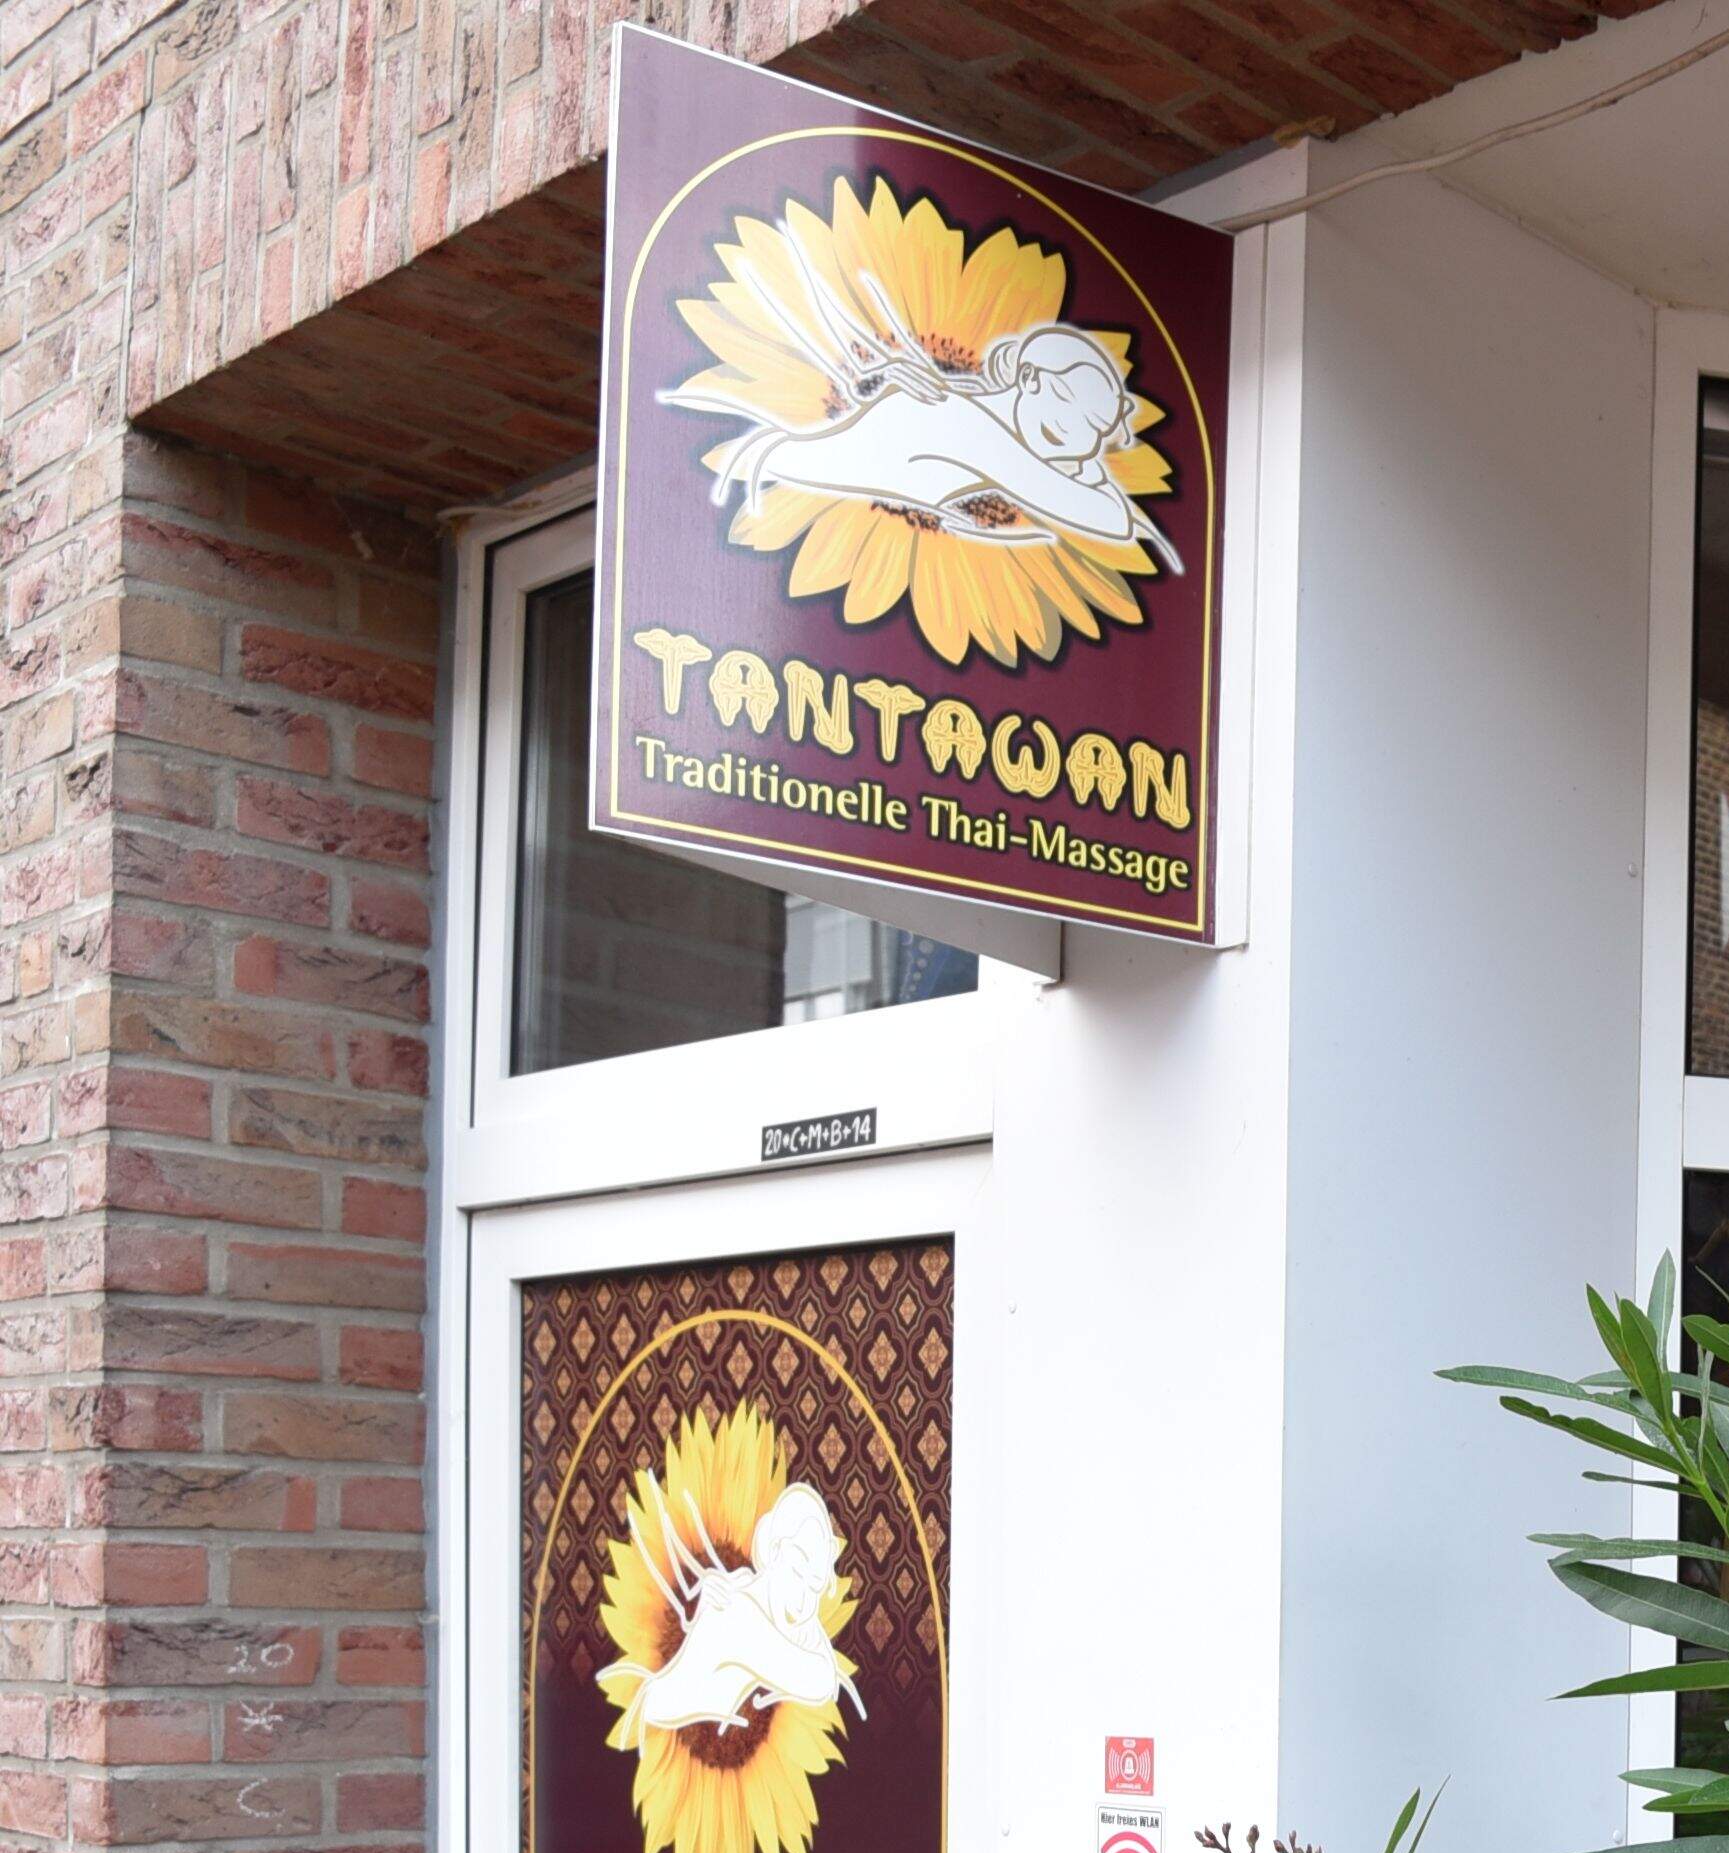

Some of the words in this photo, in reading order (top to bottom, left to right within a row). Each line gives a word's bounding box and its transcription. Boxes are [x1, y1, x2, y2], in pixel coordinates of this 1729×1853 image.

[633, 627, 1192, 830] TANTAWAN
[636, 736, 907, 831] Traditionelle
[922, 796, 1190, 893] Thai-Massage
[226, 1643, 294, 1674] 20
[1140, 1816, 1160, 1828] WLAN
